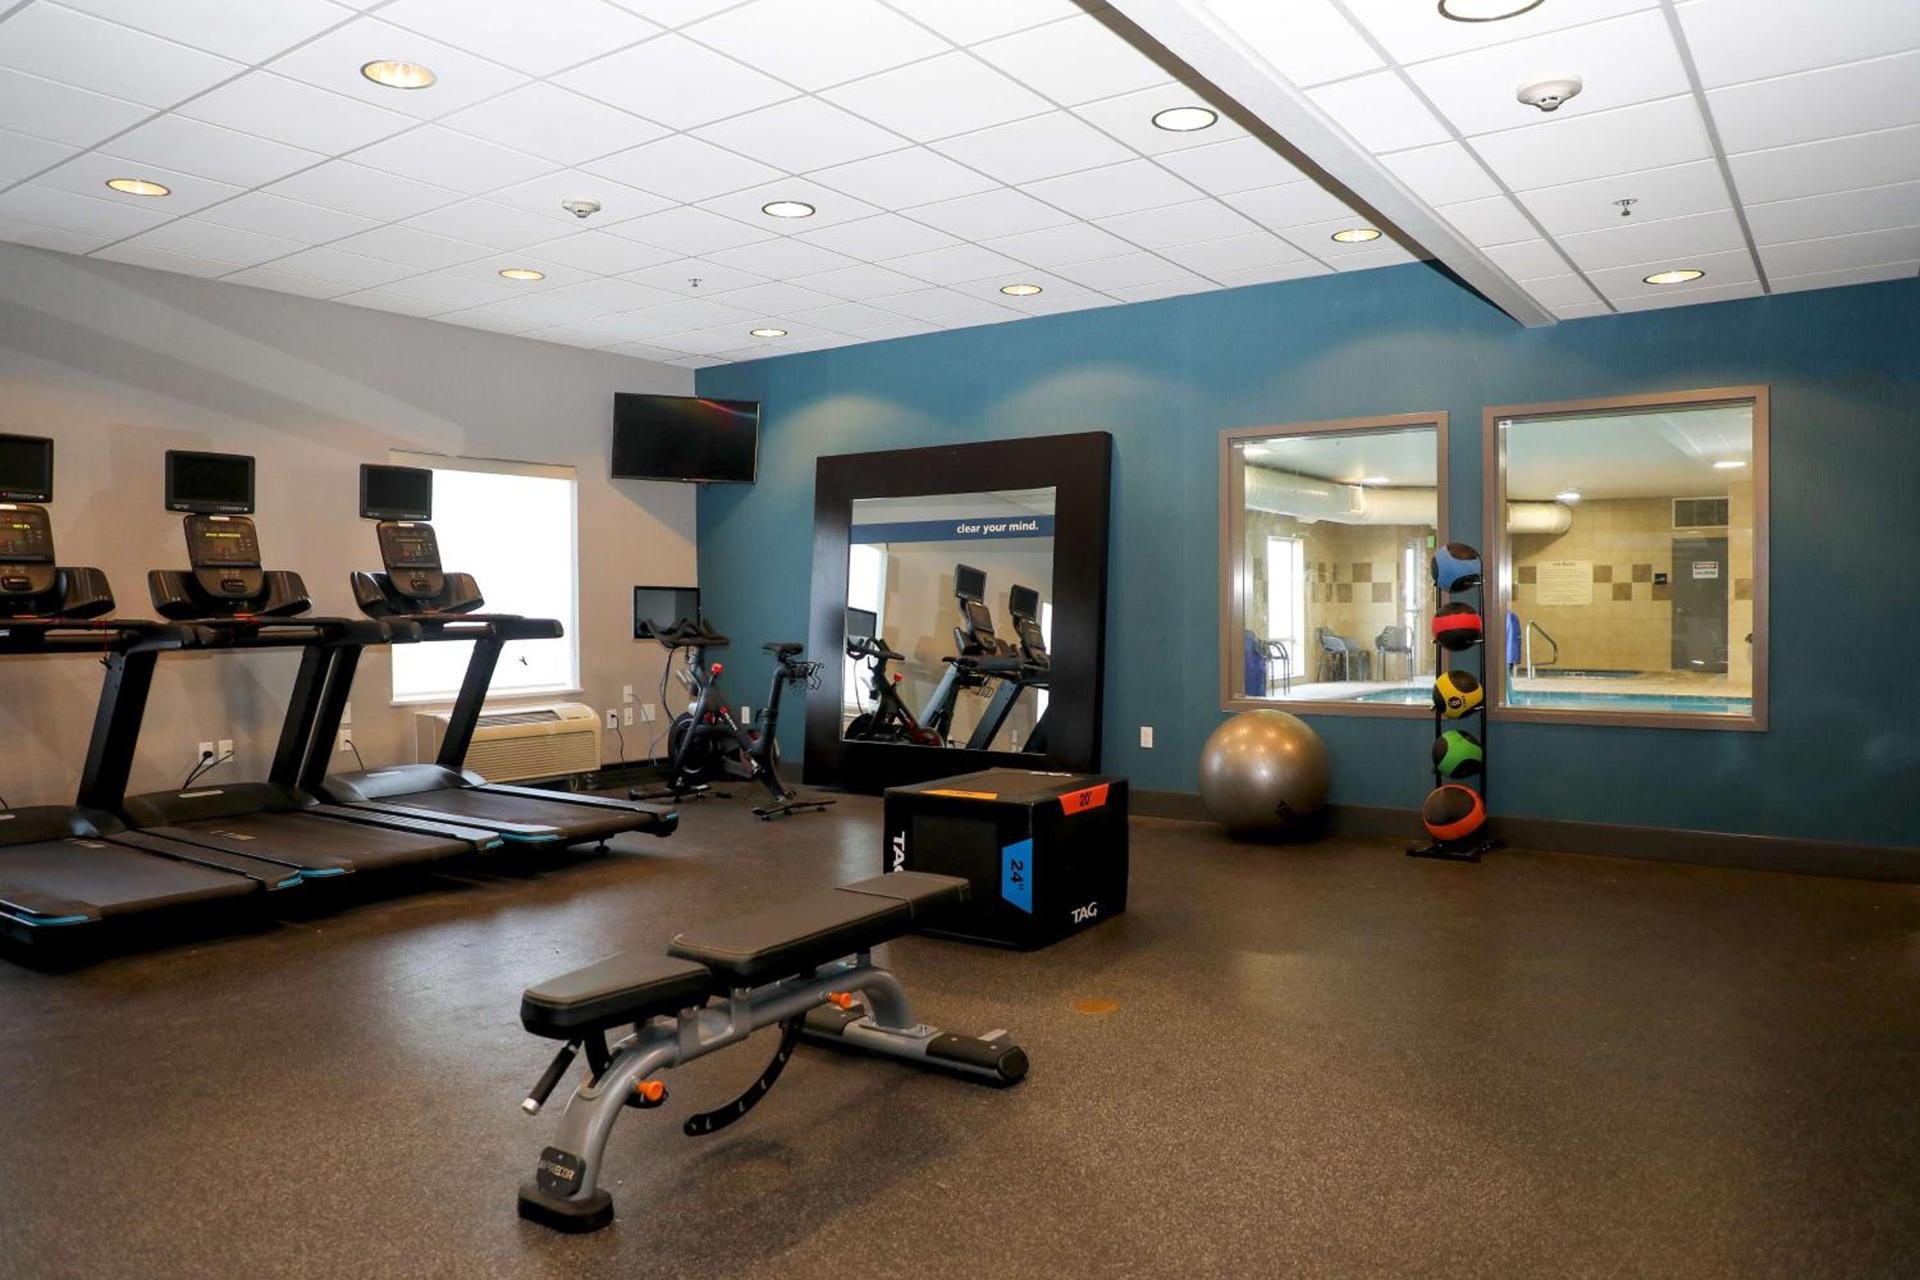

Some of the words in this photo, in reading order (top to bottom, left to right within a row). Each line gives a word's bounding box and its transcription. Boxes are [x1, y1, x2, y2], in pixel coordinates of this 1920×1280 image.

[956, 523, 981, 534] clear
[983, 523, 1007, 535] your
[1009, 520, 1039, 532] mind.
[1011, 859, 1024, 891] 24"
[1071, 901, 1098, 924] TAG
